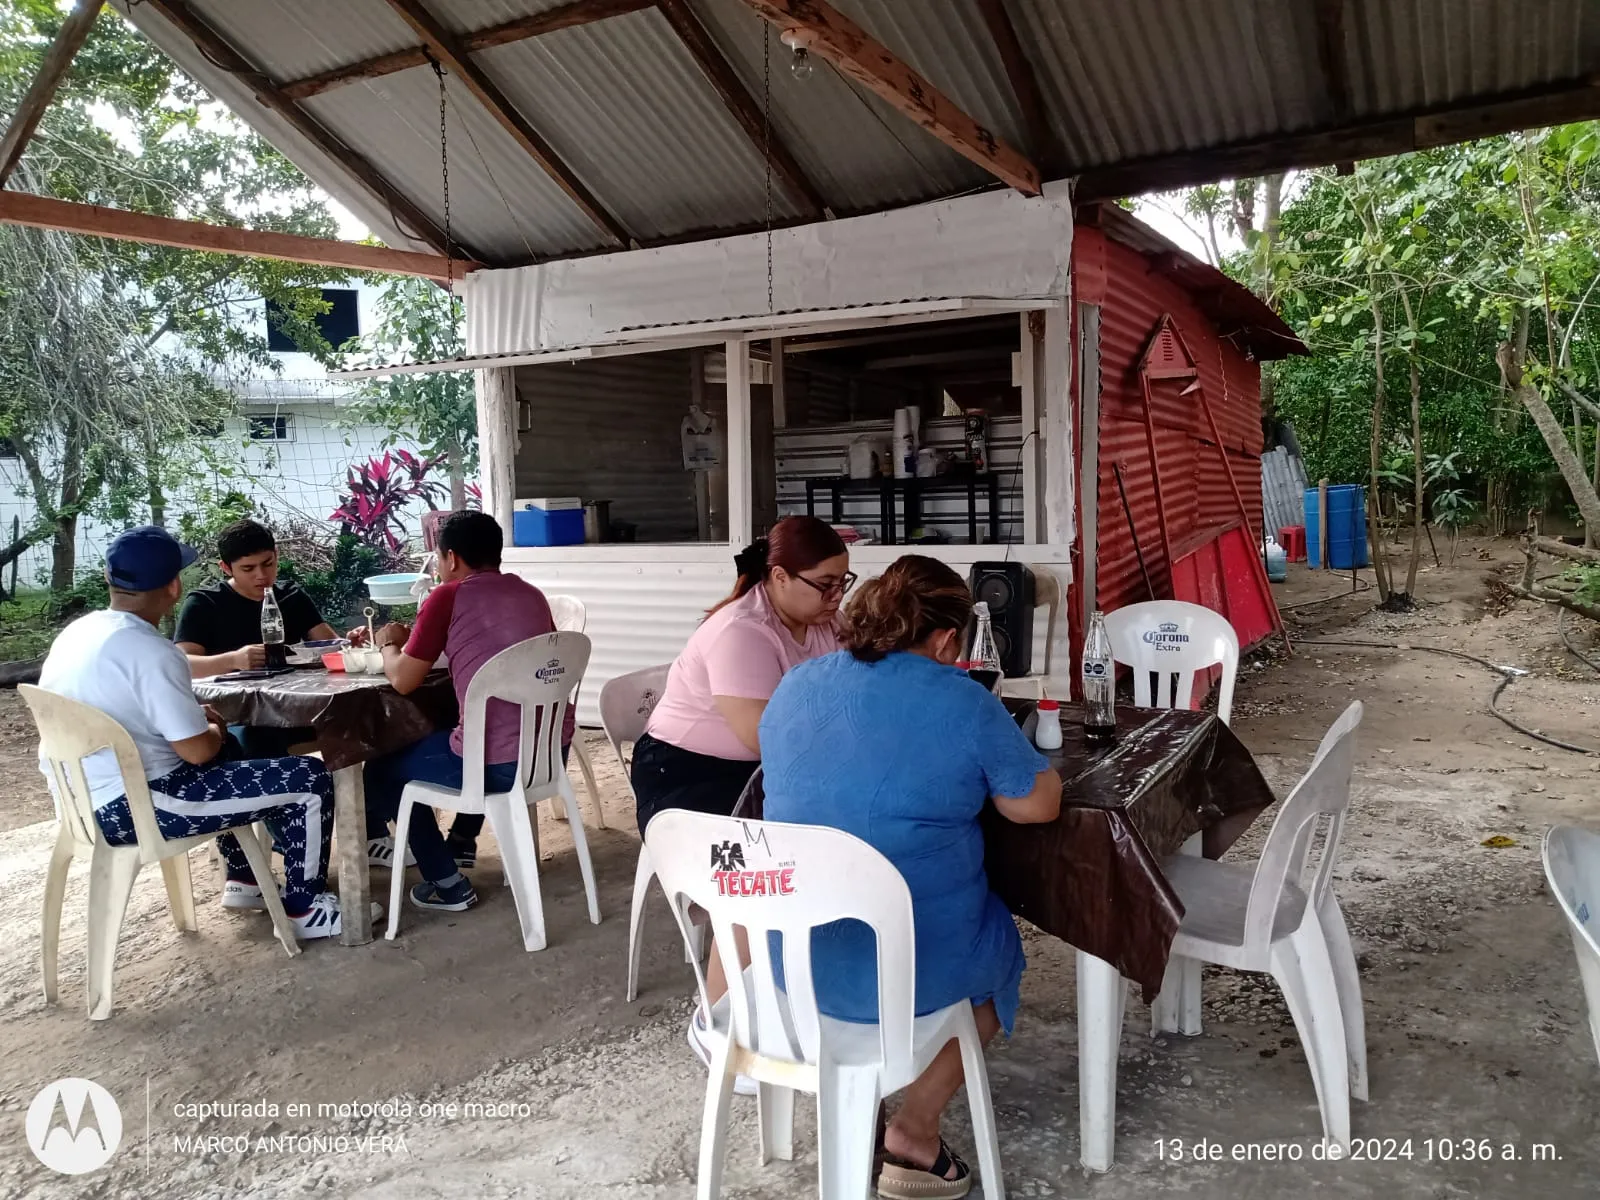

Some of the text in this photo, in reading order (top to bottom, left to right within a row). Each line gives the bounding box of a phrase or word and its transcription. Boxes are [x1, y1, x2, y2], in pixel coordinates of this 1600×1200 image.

[1142, 630, 1190, 645] Corona
[1156, 642, 1181, 652] Extra
[535, 666, 565, 680] Corona
[252, 770, 263, 784] NY
[280, 771, 292, 786] NY
[176, 784, 188, 798] NY
[203, 788, 216, 802] NY
[742, 821, 772, 857] M
[712, 868, 796, 897] TECATE
